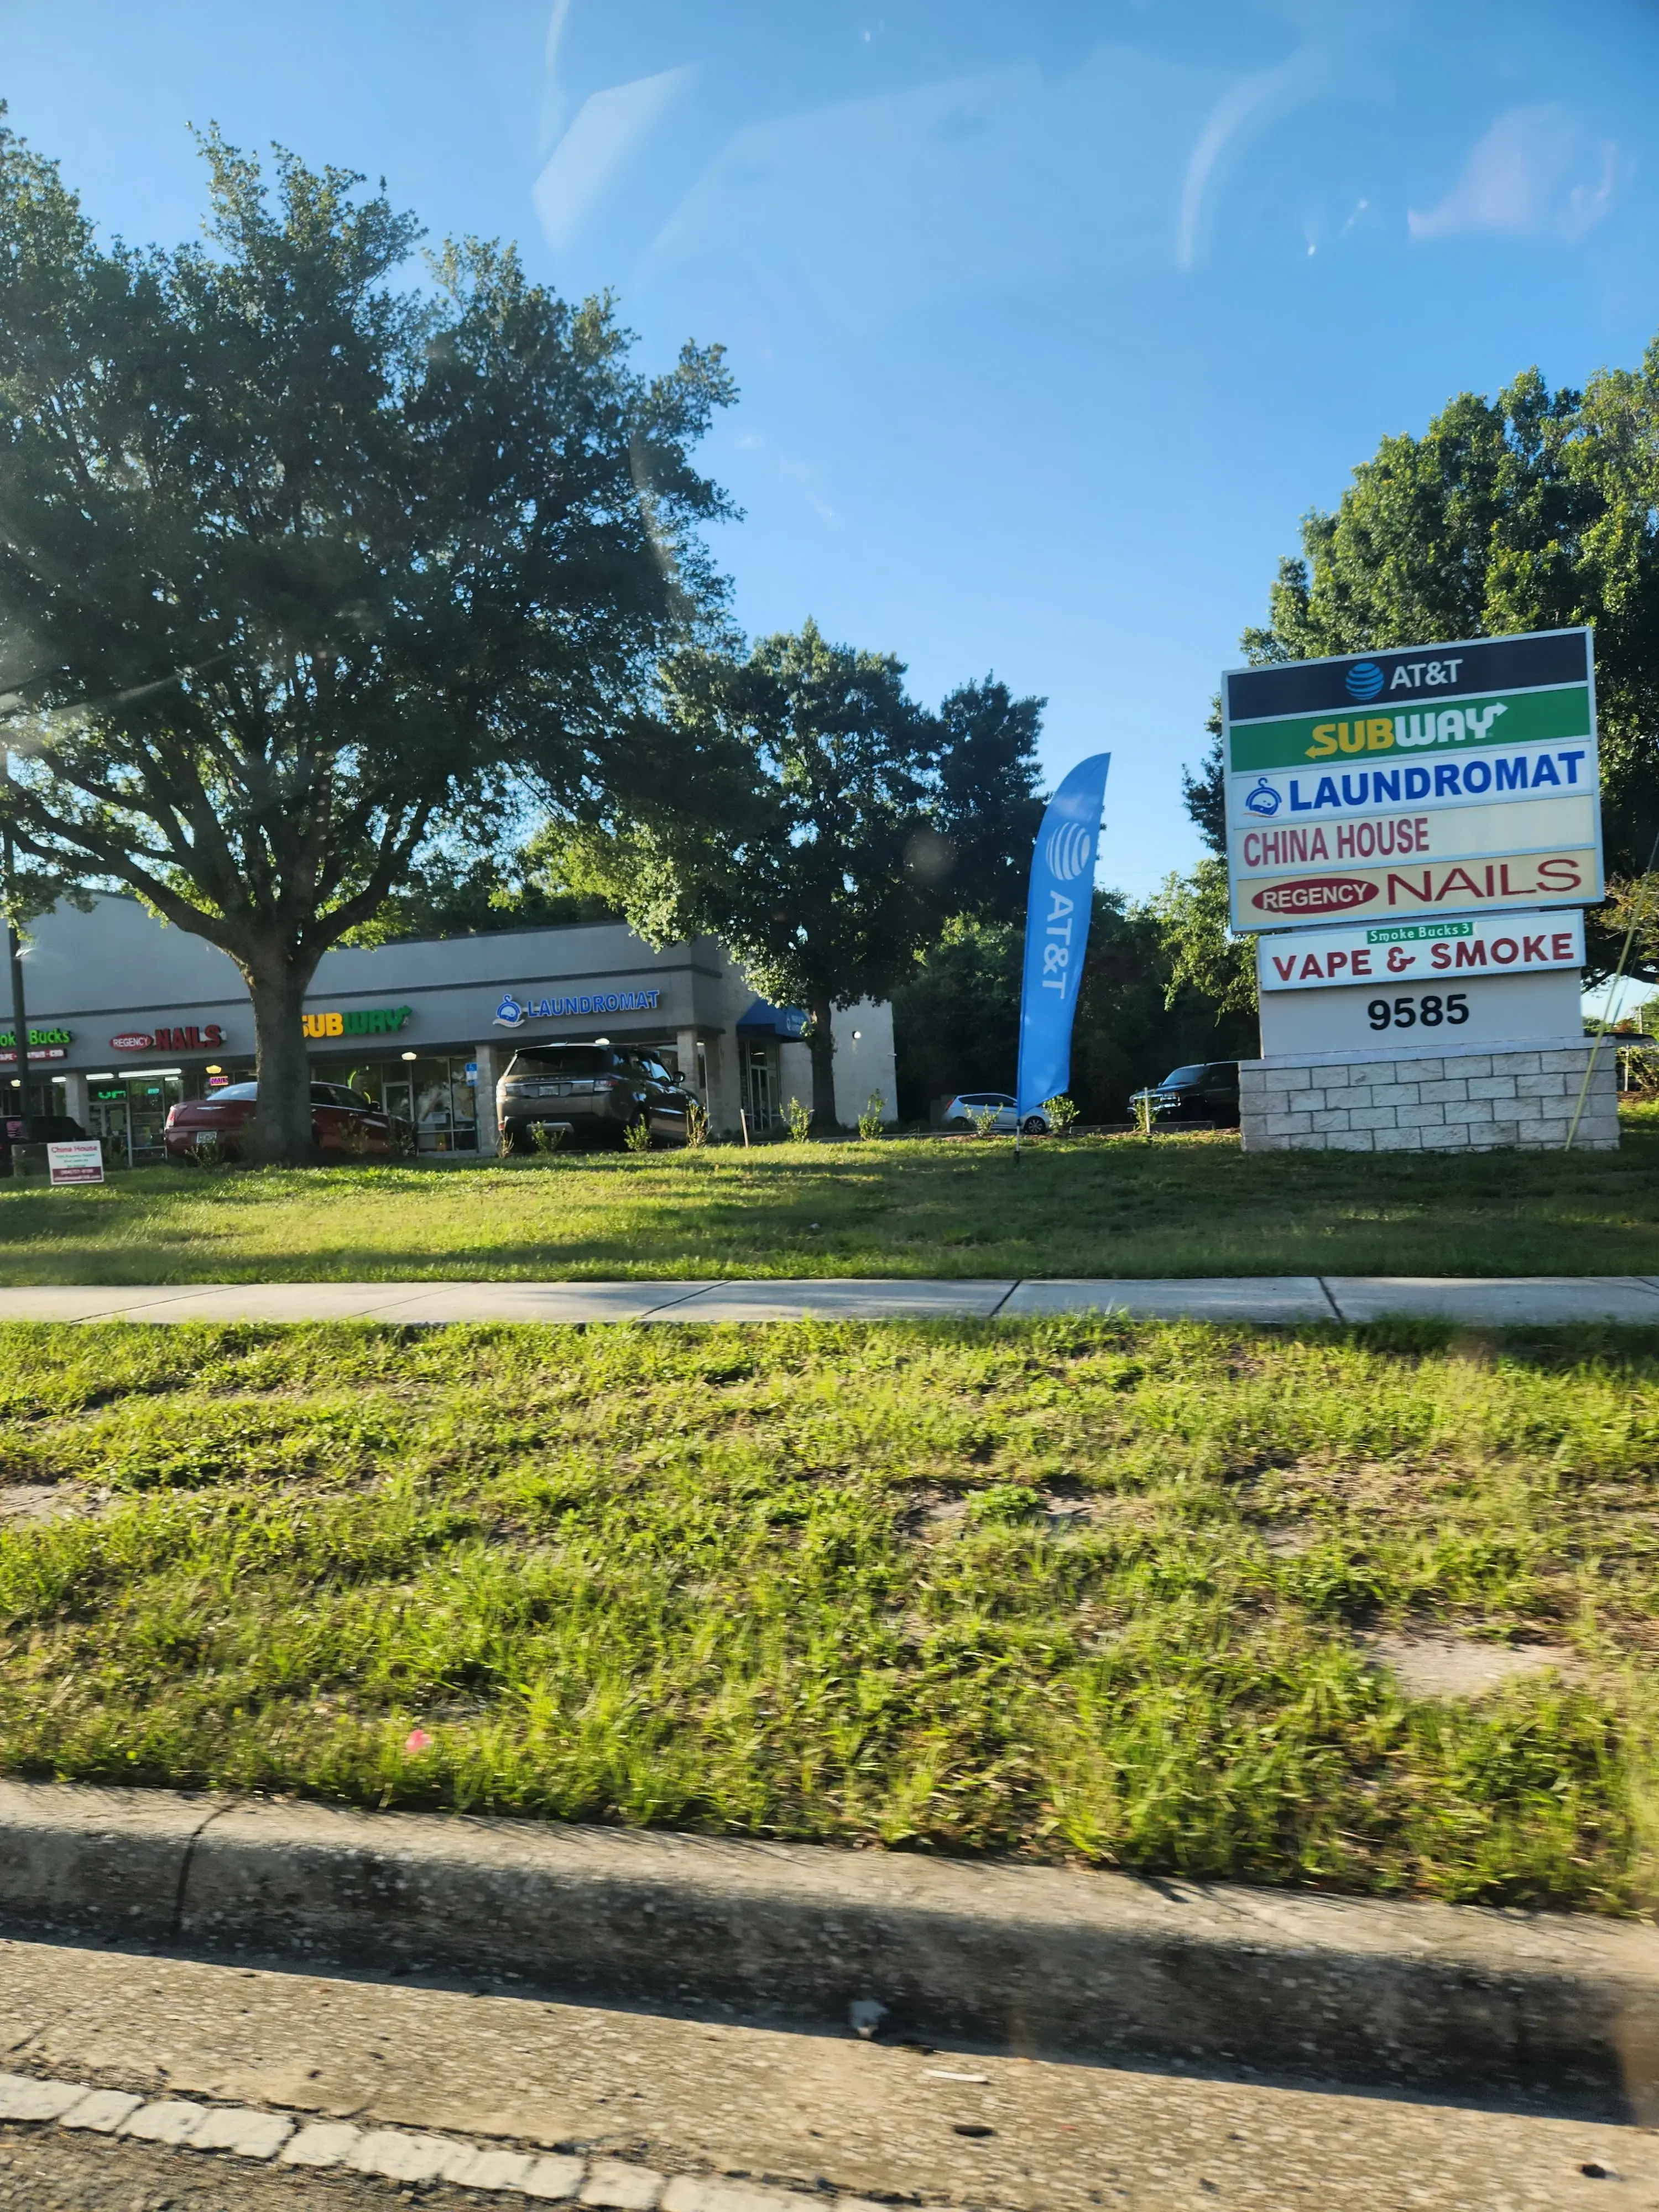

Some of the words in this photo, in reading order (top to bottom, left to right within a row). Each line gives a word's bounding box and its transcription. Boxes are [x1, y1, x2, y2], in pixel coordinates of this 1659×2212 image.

[1390, 659, 1463, 690] AT&T
[1305, 702, 1509, 760] SUBWAY
[1290, 750, 1585, 812] LAUNDROMAT
[1244, 827, 1329, 867] CHINA
[1337, 817, 1430, 859] HOUSE
[1262, 883, 1369, 910] REGENCY
[1387, 858, 1582, 905] NAILS
[1042, 890, 1074, 999] AT&T
[1370, 928, 1415, 942] Smoke
[1418, 925, 1459, 938] Bucks
[1462, 923, 1470, 934] 3
[1272, 949, 1373, 982] VAPE
[1387, 946, 1416, 972] &
[1431, 933, 1574, 969] SMOKE
[526, 990, 660, 1018] LAUNDROMAT
[1368, 994, 1470, 1030] 9585
[29, 1029, 70, 1045] Bucks
[113, 1036, 148, 1047] REGENCY
[155, 1025, 221, 1050] NAILS
